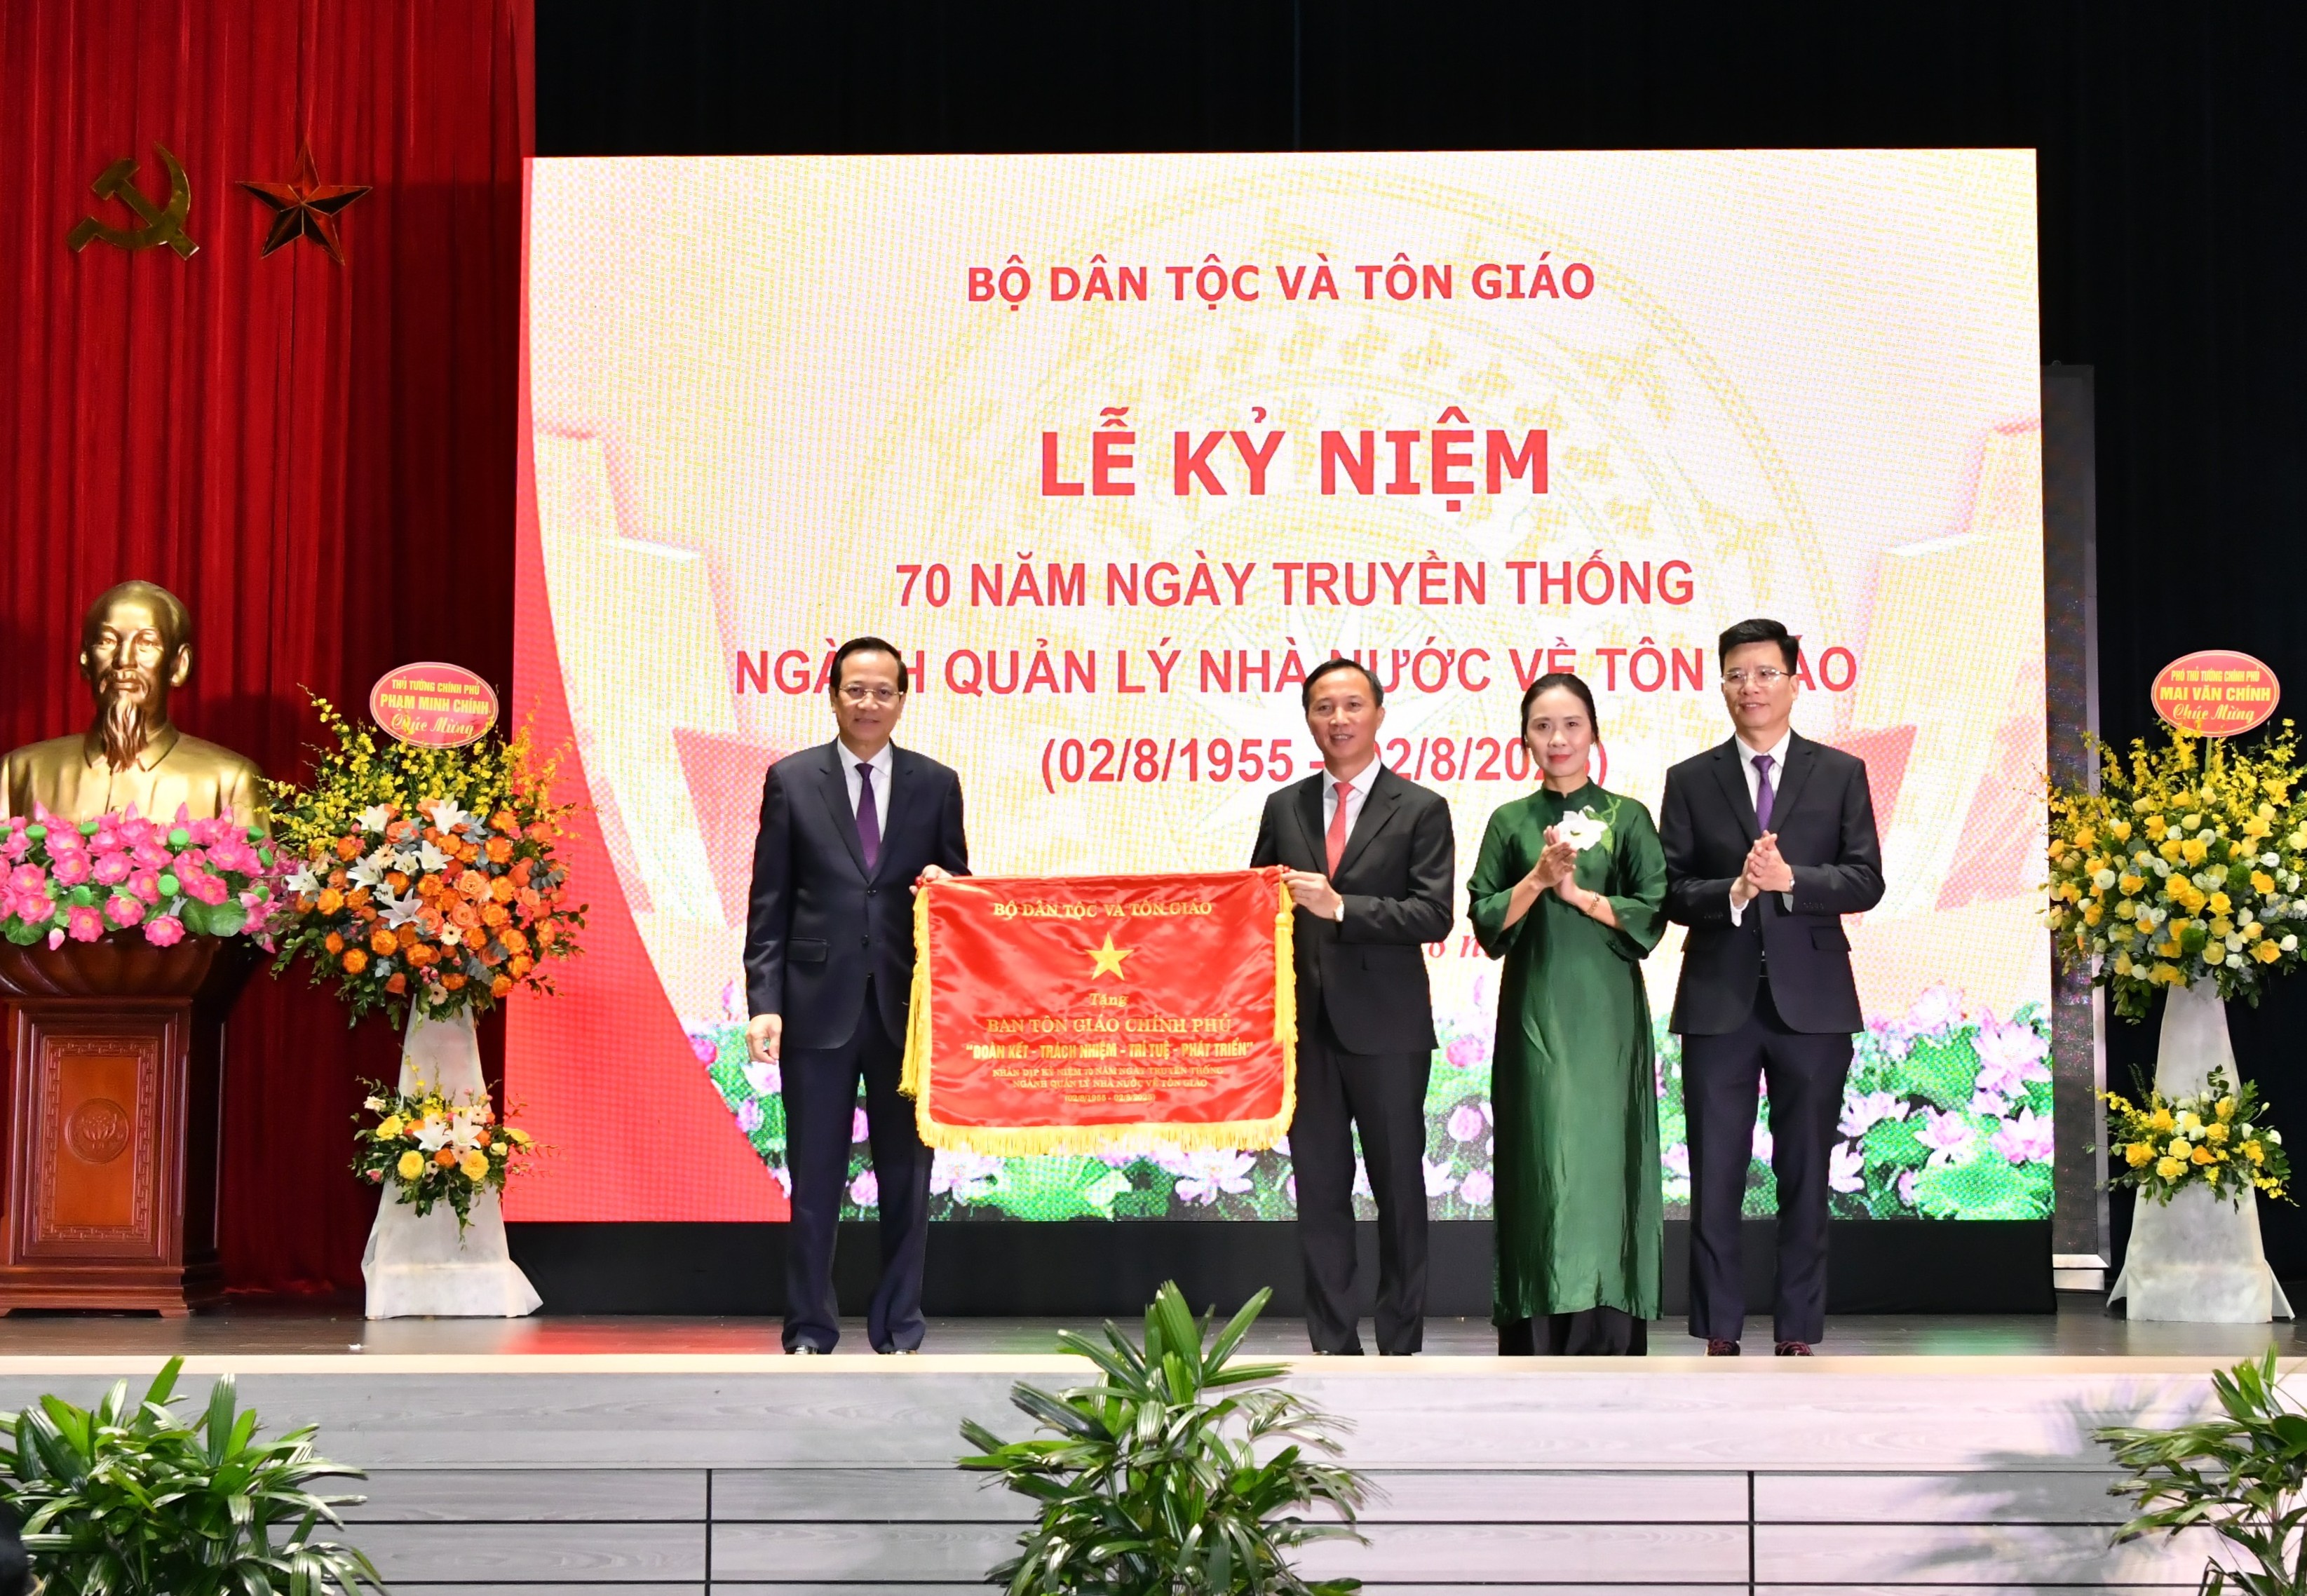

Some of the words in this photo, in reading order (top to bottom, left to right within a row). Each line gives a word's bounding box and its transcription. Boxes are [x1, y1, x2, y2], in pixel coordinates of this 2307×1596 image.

[968, 255, 1031, 311] BỘ
[1050, 254, 1147, 302] DÂN
[1165, 253, 1259, 311] TỘC
[1276, 252, 1340, 301] VÀ
[1355, 252, 1452, 301] TÔN
[1472, 252, 1595, 300] GIÁO
[1041, 407, 1135, 496] LỄ
[1174, 407, 1285, 496] KỶ
[1321, 406, 1548, 513] NIỆM
[896, 564, 951, 608] 70
[971, 552, 1085, 607] NĂM
[1107, 550, 1256, 607] NGÀY
[1273, 550, 1486, 607] TRUYỀN
[1506, 549, 1694, 606] THỐNG
[945, 638, 1096, 697] QUẢN
[1118, 637, 1181, 694] LÝ
[1200, 637, 1307, 694] NHÀ
[1595, 637, 1703, 692] TÔN
[2171, 668, 2185, 682] PHÓ
[2186, 665, 2199, 682] THỦ
[2224, 669, 2245, 682] CHÍNH
[2246, 665, 2260, 682] PHỦ
[392, 676, 407, 689] THỦ
[438, 681, 461, 694] CHÍNH
[464, 681, 480, 696] PHỦ
[2160, 687, 2188, 701] MAI
[2193, 684, 2222, 701] VĂN
[2226, 684, 2271, 701] CHÍNH
[380, 694, 415, 711] PHẠM
[419, 696, 450, 712] MINH
[453, 697, 489, 715] CHÍNH
[2173, 703, 2208, 720] Chúc
[1042, 738, 1293, 794] (02/8/1955
[994, 901, 1017, 920] BỘ
[1022, 900, 1057, 917] DÂN
[1063, 900, 1097, 920] TỘC
[1130, 900, 1164, 917] TÔN
[1169, 898, 1212, 915] GIÁO
[987, 1019, 1024, 1033] BAN
[1029, 1015, 1068, 1034] TÔN
[1073, 1014, 1120, 1033] GIÁO
[1125, 1015, 1187, 1033] CHÍNH
[1191, 1013, 1231, 1033] PHỦ
[1008, 1041, 1029, 1059] KẾT
[1039, 1042, 1076, 1059] TRÁCH
[1079, 1041, 1117, 1060] NHIỆM
[1181, 1041, 1210, 1057] PHÁT
